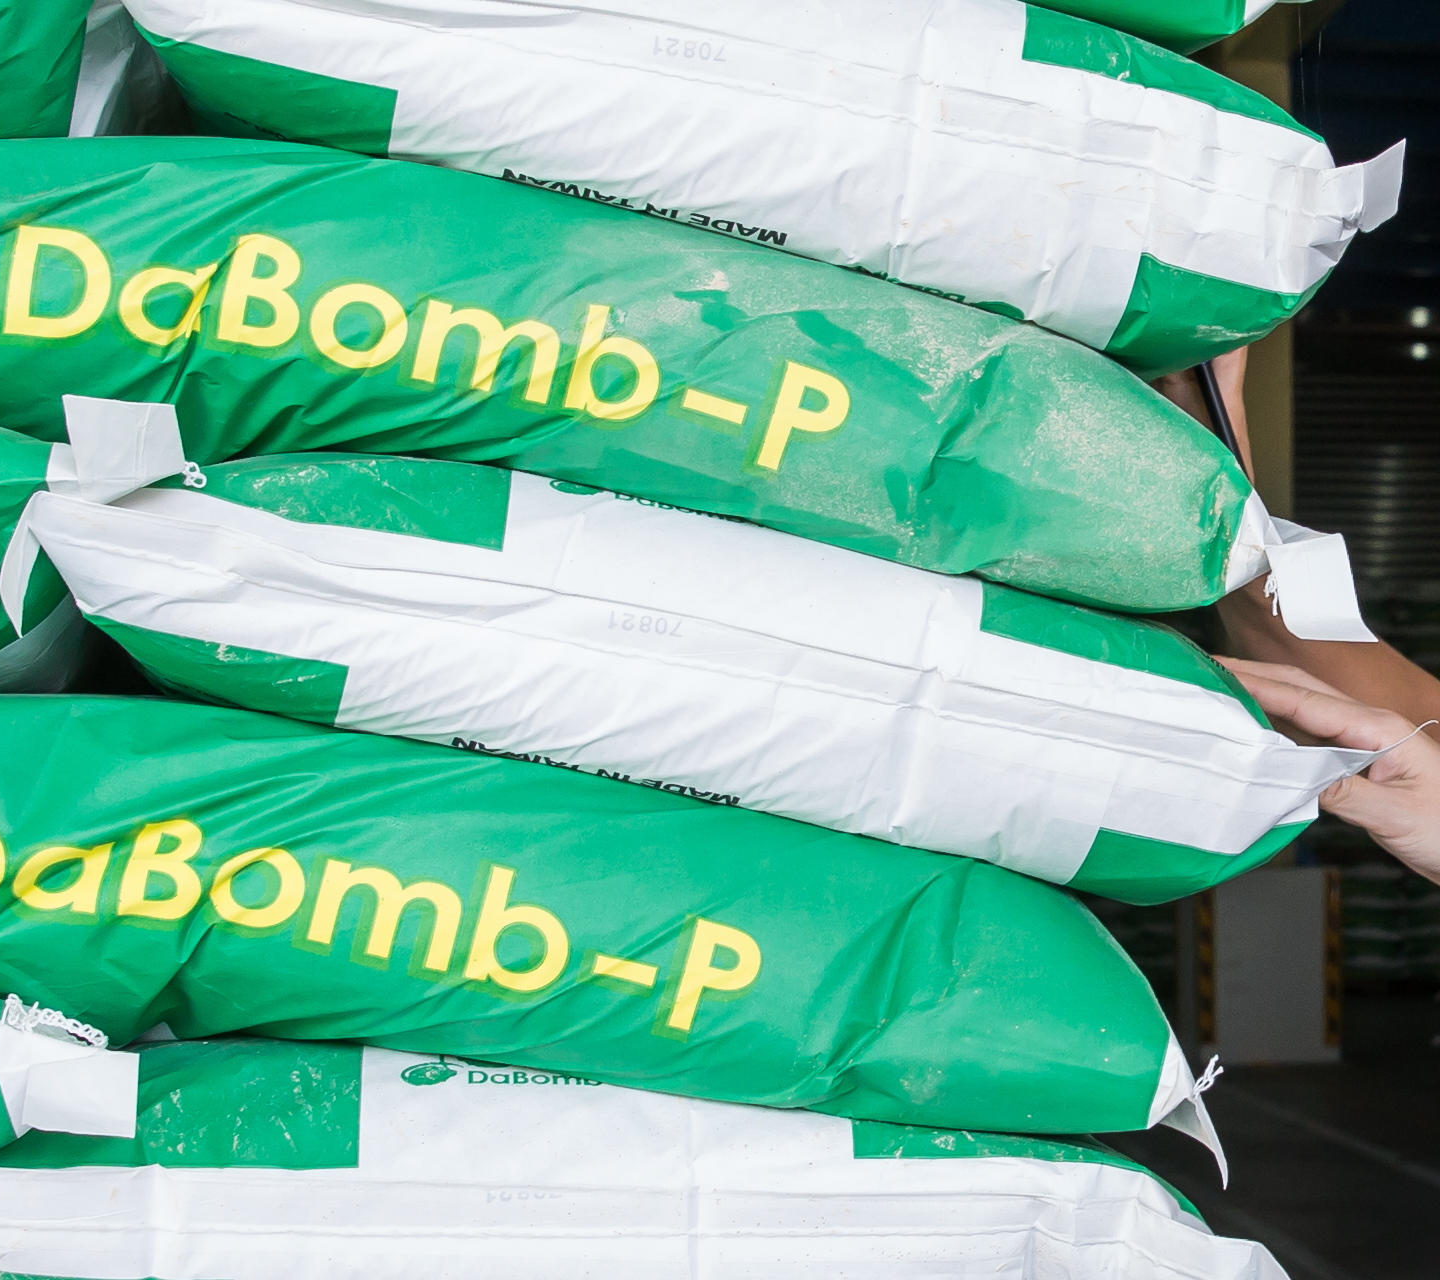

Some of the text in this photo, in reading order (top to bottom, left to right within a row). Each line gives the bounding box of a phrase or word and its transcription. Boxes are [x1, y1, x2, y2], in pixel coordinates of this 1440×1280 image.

[650, 33, 729, 66] 70821
[644, 201, 679, 220] IN
[687, 212, 788, 247] MADE
[3, 224, 851, 472] DaBomb-P
[605, 610, 684, 640] 70821
[640, 778, 741, 806] MADE
